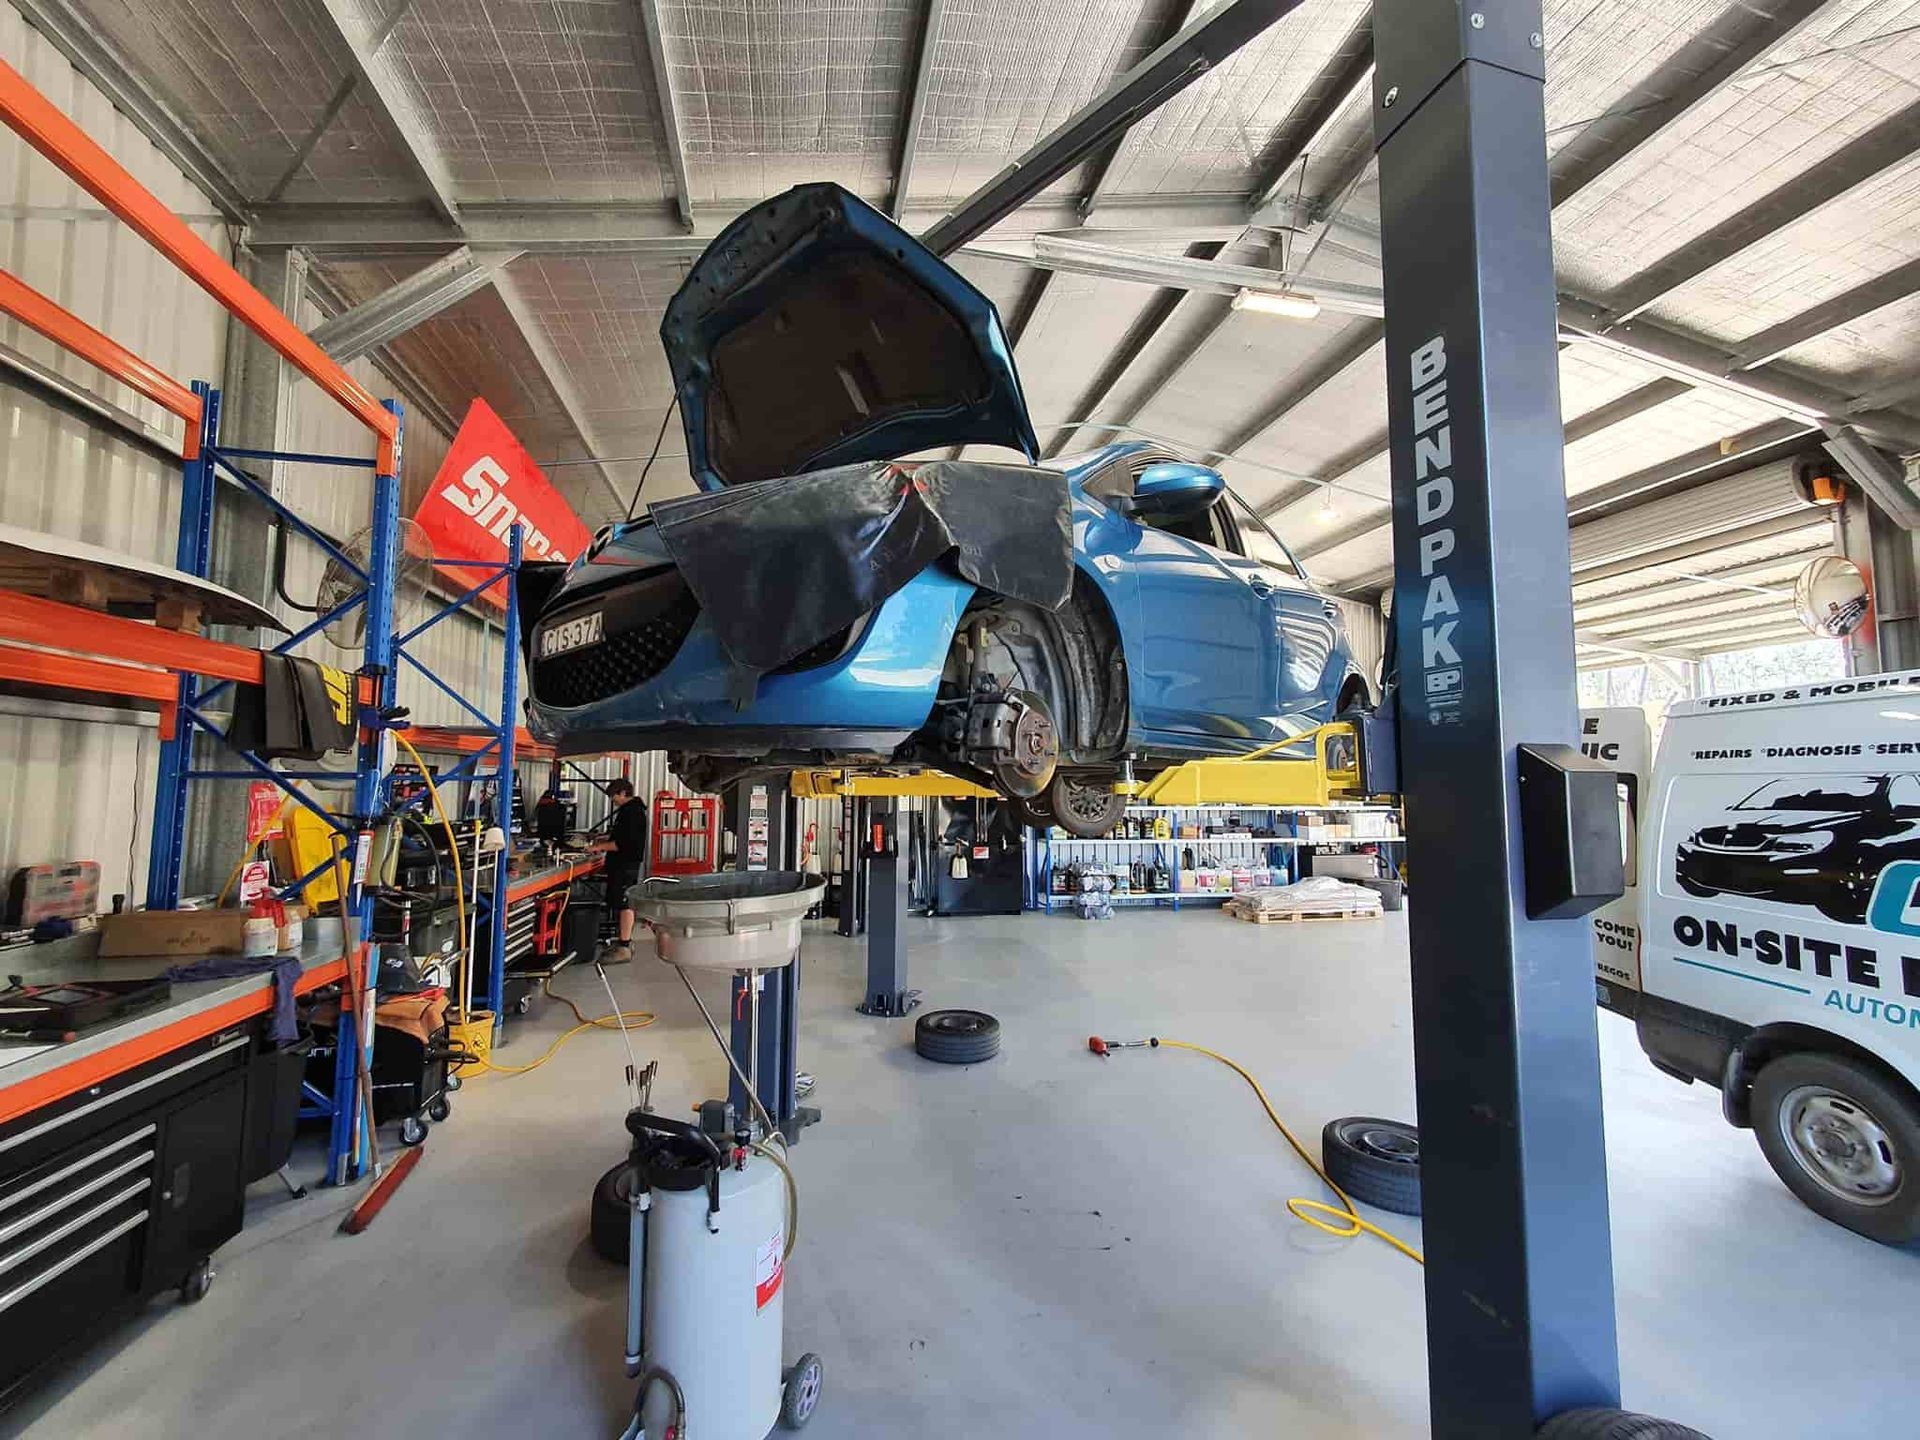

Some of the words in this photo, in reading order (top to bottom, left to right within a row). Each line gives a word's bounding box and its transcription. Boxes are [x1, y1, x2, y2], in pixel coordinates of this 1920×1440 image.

[1411, 335, 1463, 668] BENDPAK
[1709, 693, 1775, 708] FIXED
[1783, 689, 1801, 700] &
[1695, 749, 1752, 760] REPAIRS
[1767, 744, 1862, 758] DIAGNOSIS
[1594, 919, 1635, 938] COME
[1673, 915, 1880, 988] ON-SITE
